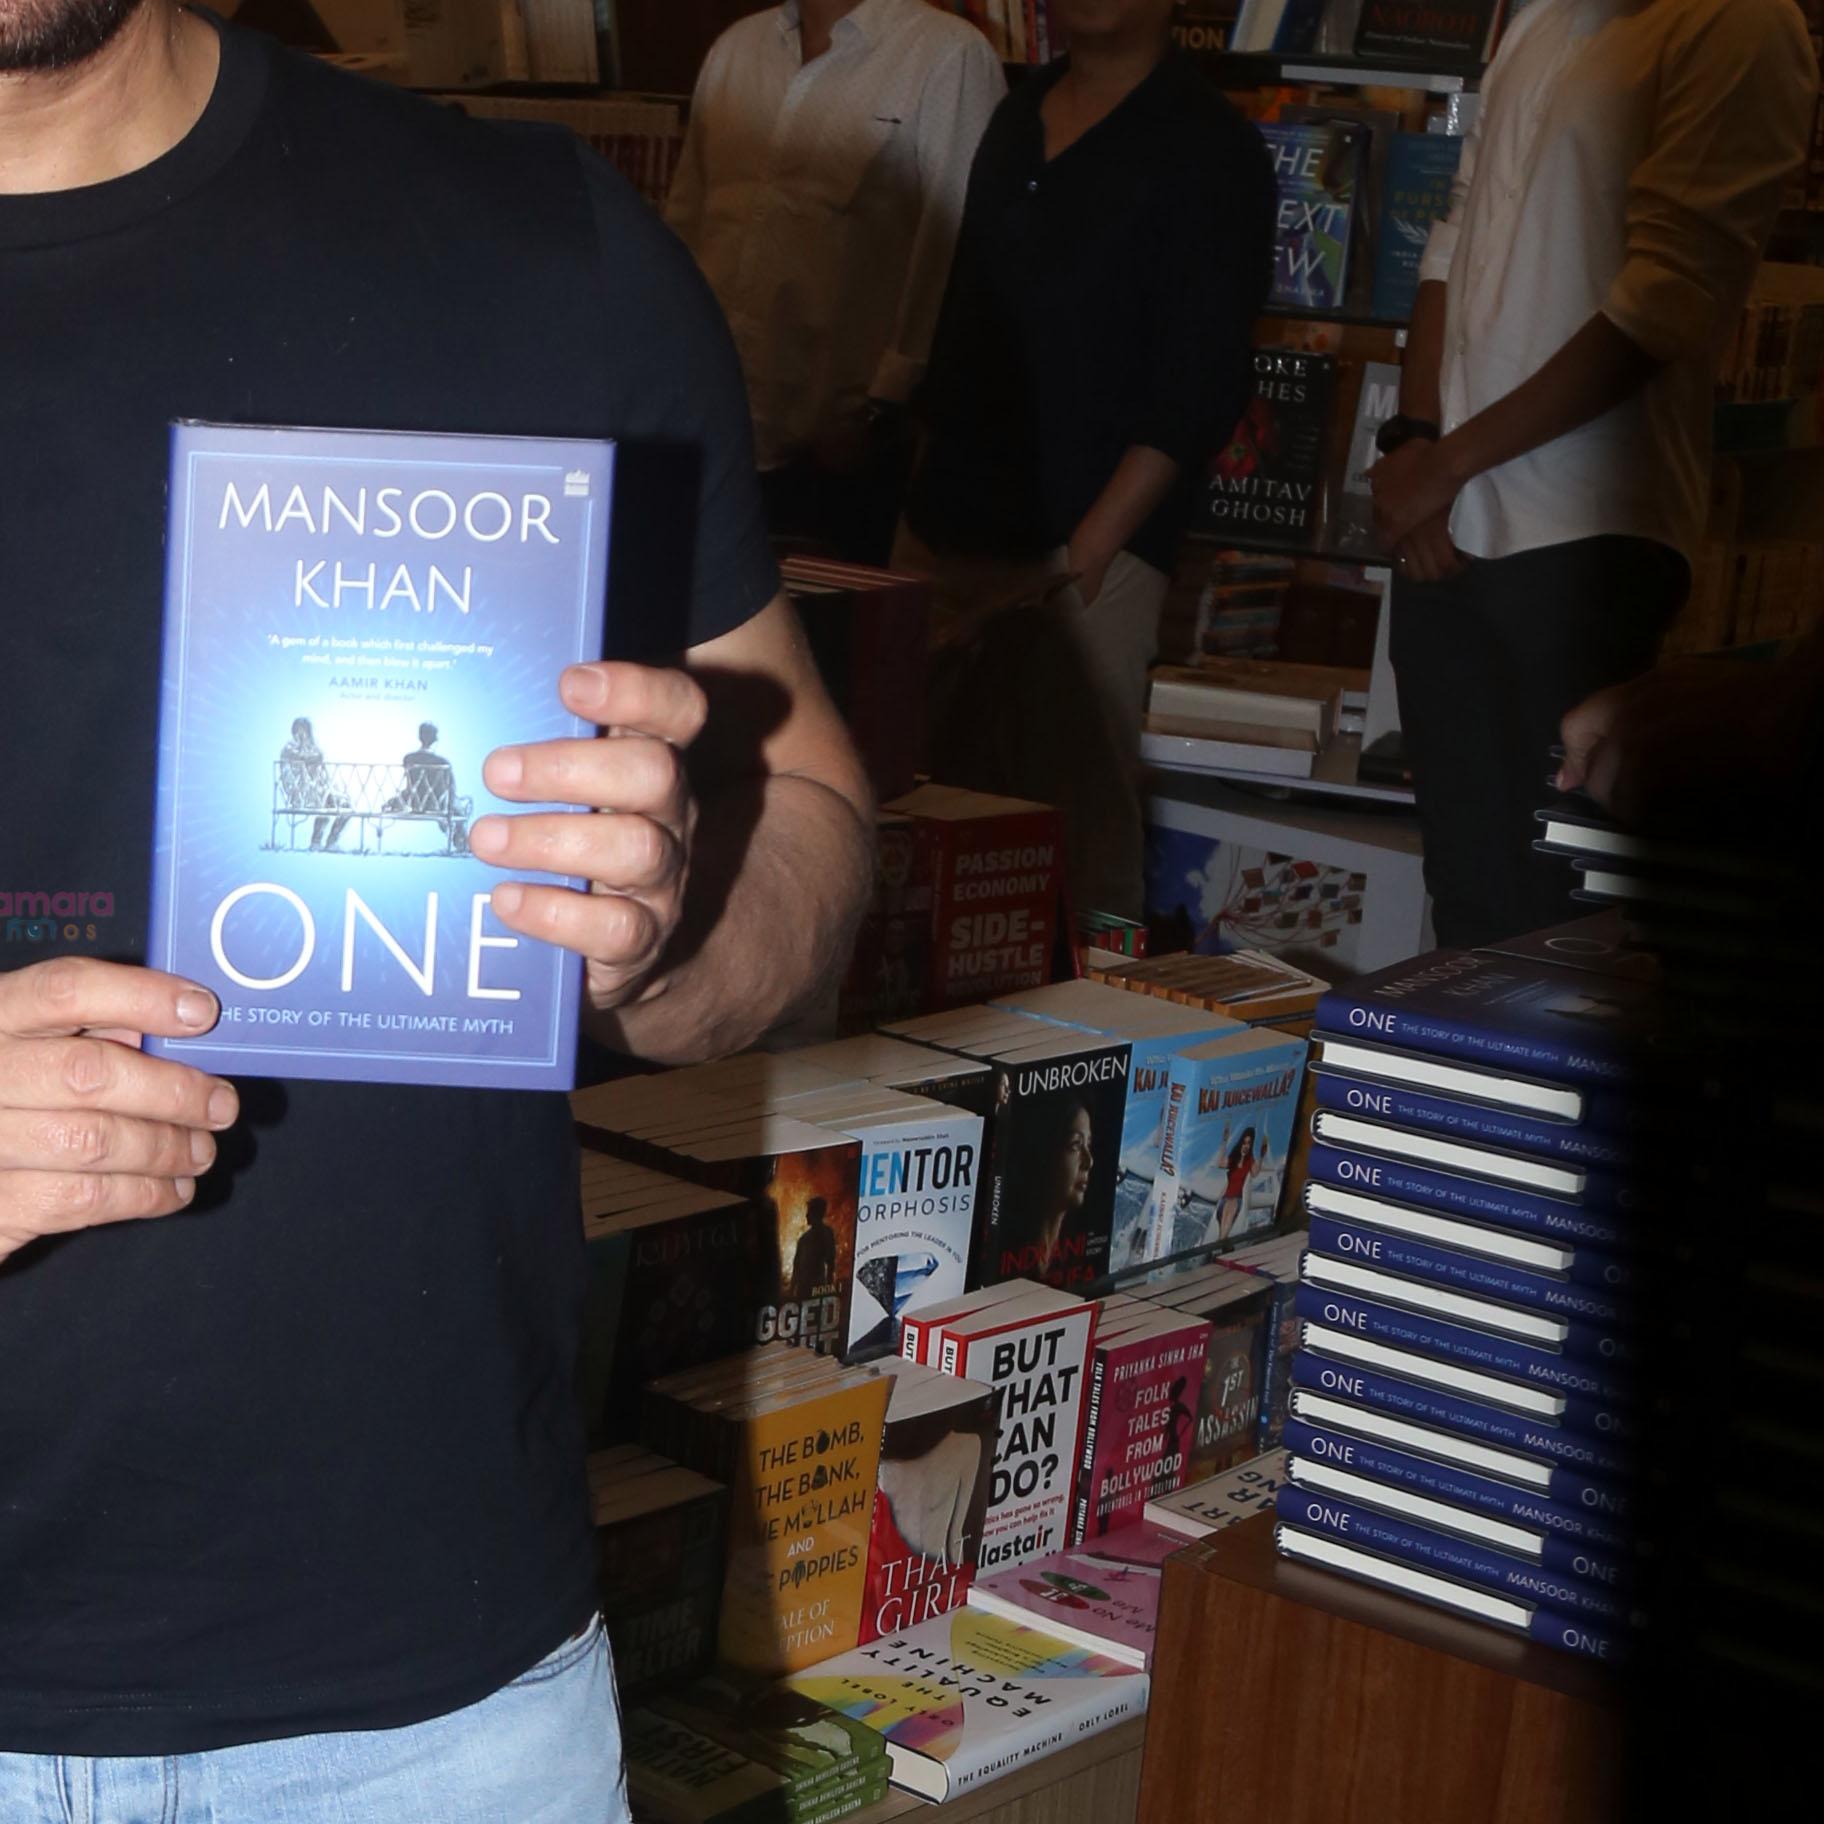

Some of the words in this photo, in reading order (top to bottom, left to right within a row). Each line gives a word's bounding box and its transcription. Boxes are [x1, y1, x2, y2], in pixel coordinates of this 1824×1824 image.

[1209, 474, 1313, 502] AMITAV
[218, 481, 560, 544] MANSOOR
[1211, 498, 1306, 526] GHOSH
[294, 558, 473, 615] KHAN
[328, 677, 379, 690] AAMIR
[384, 679, 429, 691] KHAN
[954, 843, 1056, 877] PASSION
[951, 873, 1051, 903] ECONOMY
[210, 882, 522, 1000] ONE
[948, 908, 1047, 950] SIDE-
[946, 943, 1045, 979] HUSTLE
[247, 1007, 303, 1025] STORY
[308, 1010, 331, 1026] OF
[339, 1012, 372, 1028] THE
[378, 1014, 457, 1032] ULTIMATE
[462, 1018, 514, 1034] MYTH
[1348, 1007, 1397, 1034] ONE
[1017, 1053, 1129, 1098] UNBROKEN
[1197, 1085, 1220, 1116] KAI
[1221, 1067, 1297, 1110] JUICEWALLA?
[1323, 1303, 1368, 1330] ONE
[992, 1327, 1067, 1382] BUT
[1113, 1356, 1156, 1384] PRIYANKA
[1157, 1348, 1185, 1369] SINHA
[1187, 1342, 1206, 1361] JHA
[1134, 1381, 1172, 1409] FOLK
[1220, 1368, 1244, 1408] 1ST
[1127, 1406, 1171, 1438] TALES
[758, 1440, 799, 1473] THE
[802, 1421, 864, 1460] BOMB,
[1124, 1433, 1165, 1463] FROM
[754, 1476, 794, 1512] THE
[798, 1457, 861, 1496] BANK,
[988, 1453, 1059, 1509] DO?
[1099, 1452, 1183, 1499] BOLLYWOOD
[783, 1489, 867, 1538] MULLAH
[778, 1544, 859, 1592] POPPIES
[786, 1535, 815, 1559] AND
[880, 1533, 972, 1598] THAT
[1306, 1503, 1352, 1533] ONE
[1506, 1571, 1578, 1607] MANSOOR
[875, 1576, 963, 1638] GIRL
[957, 1772, 976, 1787] THE
[977, 1753, 1020, 1778] EQUALITY
[1023, 1732, 1064, 1756] MACHINE
[1078, 1713, 1102, 1732] ORLY
[1103, 1702, 1129, 1722] LOBEL
